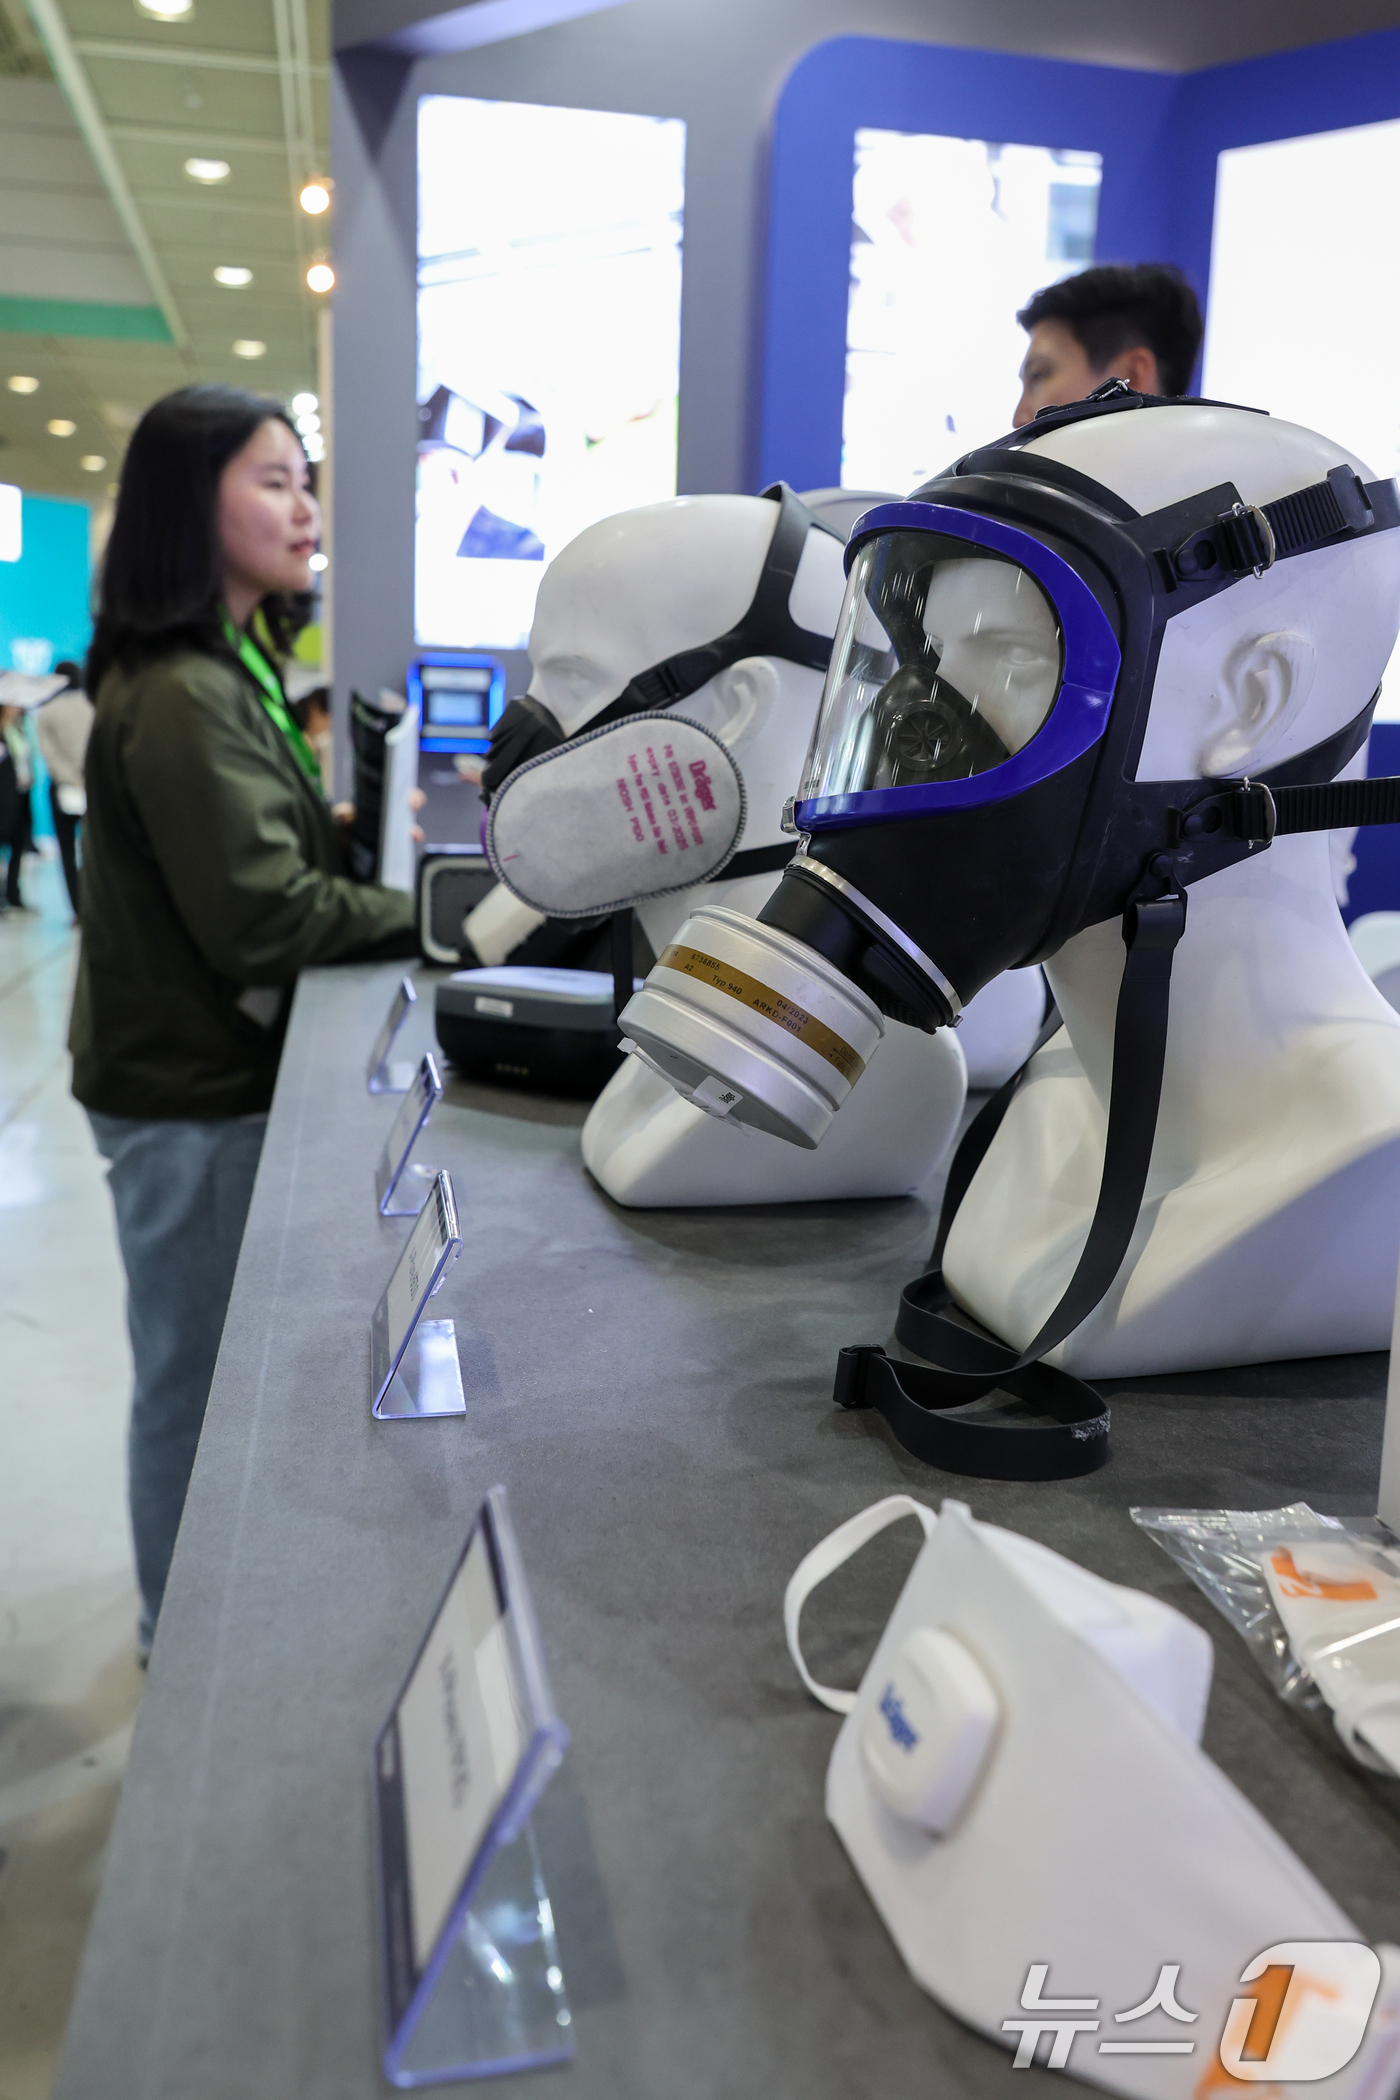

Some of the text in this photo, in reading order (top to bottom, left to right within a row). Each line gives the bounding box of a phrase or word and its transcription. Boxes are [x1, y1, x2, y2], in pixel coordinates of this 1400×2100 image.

[688, 760, 716, 811] Dräger
[690, 953, 721, 971] 6738855
[684, 963, 743, 995] A2 Typ 940
[752, 998, 802, 1033] ARKD-F001
[776, 999, 809, 1025] 04/2023
